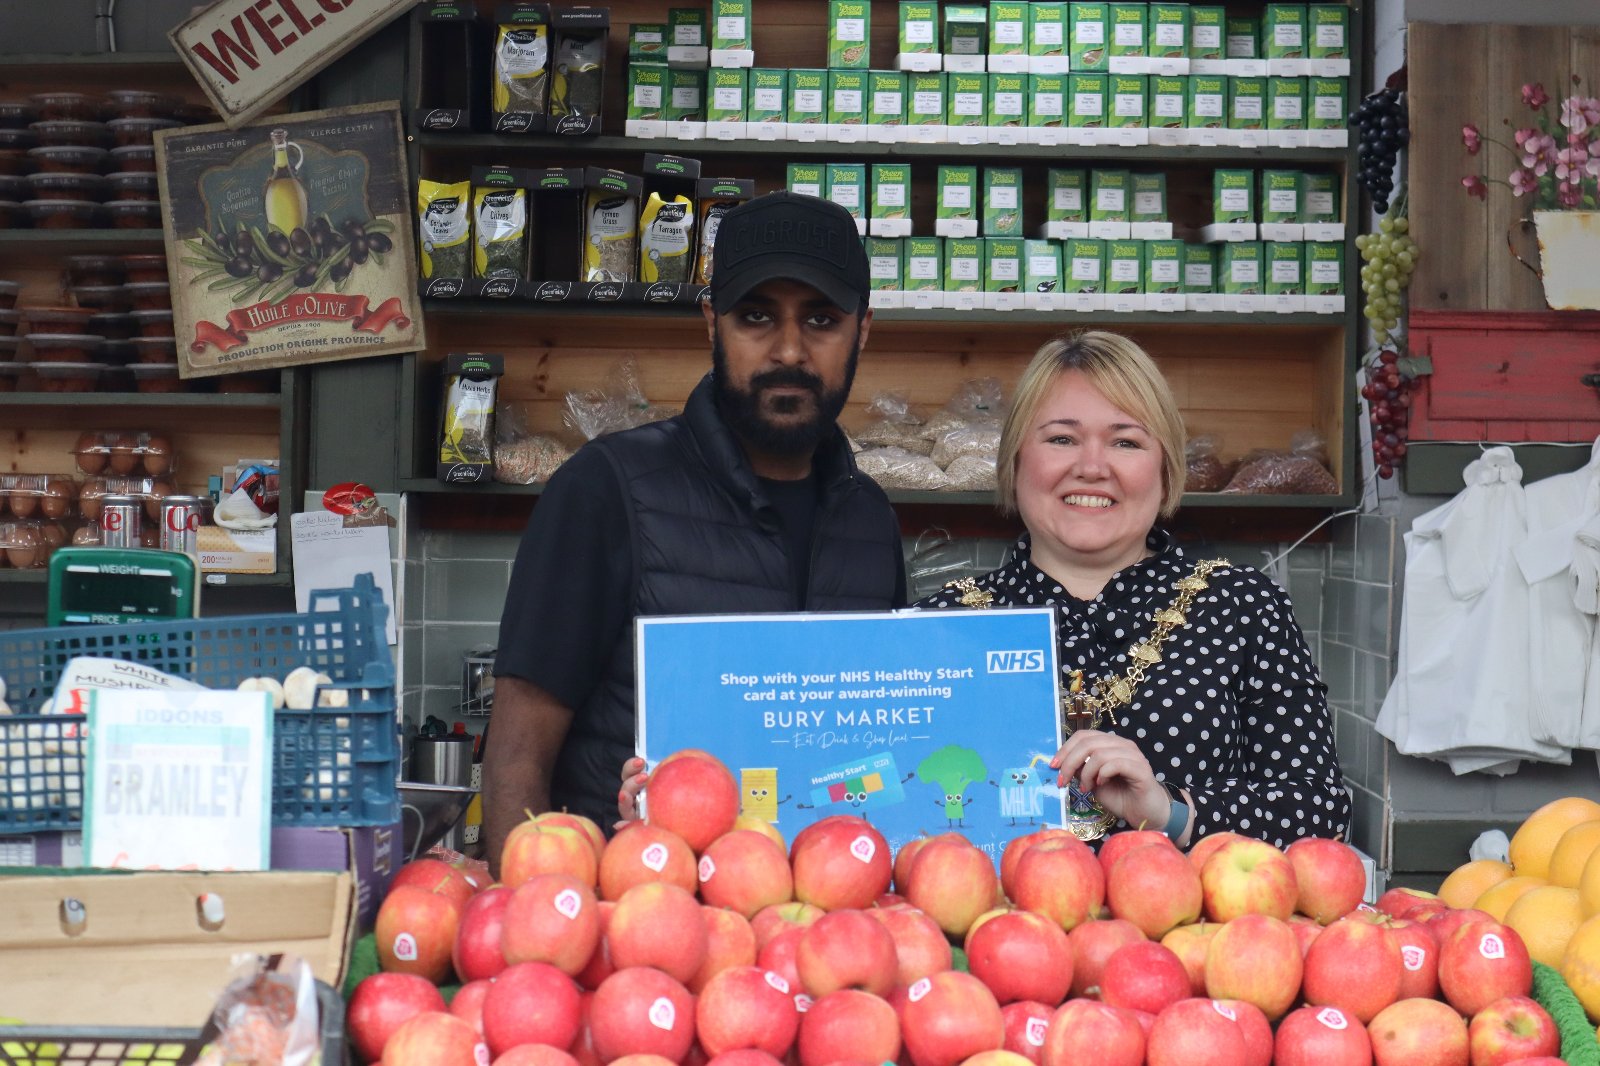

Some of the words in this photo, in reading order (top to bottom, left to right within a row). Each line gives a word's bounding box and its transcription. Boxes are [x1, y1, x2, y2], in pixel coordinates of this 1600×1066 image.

[507, 46, 535, 57] Marjoram
[310, 128, 343, 137] VIERGE
[346, 124, 374, 133] EXTRA
[186, 143, 225, 153] GARANTIE
[602, 211, 619, 219] Lemon
[659, 225, 683, 235] Tarragon
[247, 303, 289, 327] HUILE
[217, 343, 284, 363] PRODUCTION
[286, 336, 329, 349] ORIGINE
[331, 336, 386, 345] PROVENCE
[476, 385, 491, 394] Herbs
[202, 556, 216, 564] 200
[100, 565, 141, 575] WEIGHT
[92, 616, 120, 625] PRICE
[989, 652, 1042, 671] NHS
[113, 663, 171, 686] WHITE
[721, 674, 758, 687] Shop
[762, 673, 797, 684] with
[801, 675, 835, 687] your
[840, 671, 871, 683] NHS
[874, 670, 932, 685] Healthy
[937, 667, 974, 679] Start
[743, 690, 776, 701] card
[780, 690, 796, 701] at
[799, 690, 834, 703] your
[838, 685, 952, 700] award-winning
[764, 710, 825, 728] BURY
[837, 707, 935, 726] MARKET
[817, 731, 848, 748] Drink
[811, 769, 845, 786] Healthy
[844, 764, 868, 777] Start
[105, 763, 250, 818] BRAMLEY
[1001, 787, 1041, 817] MILK
